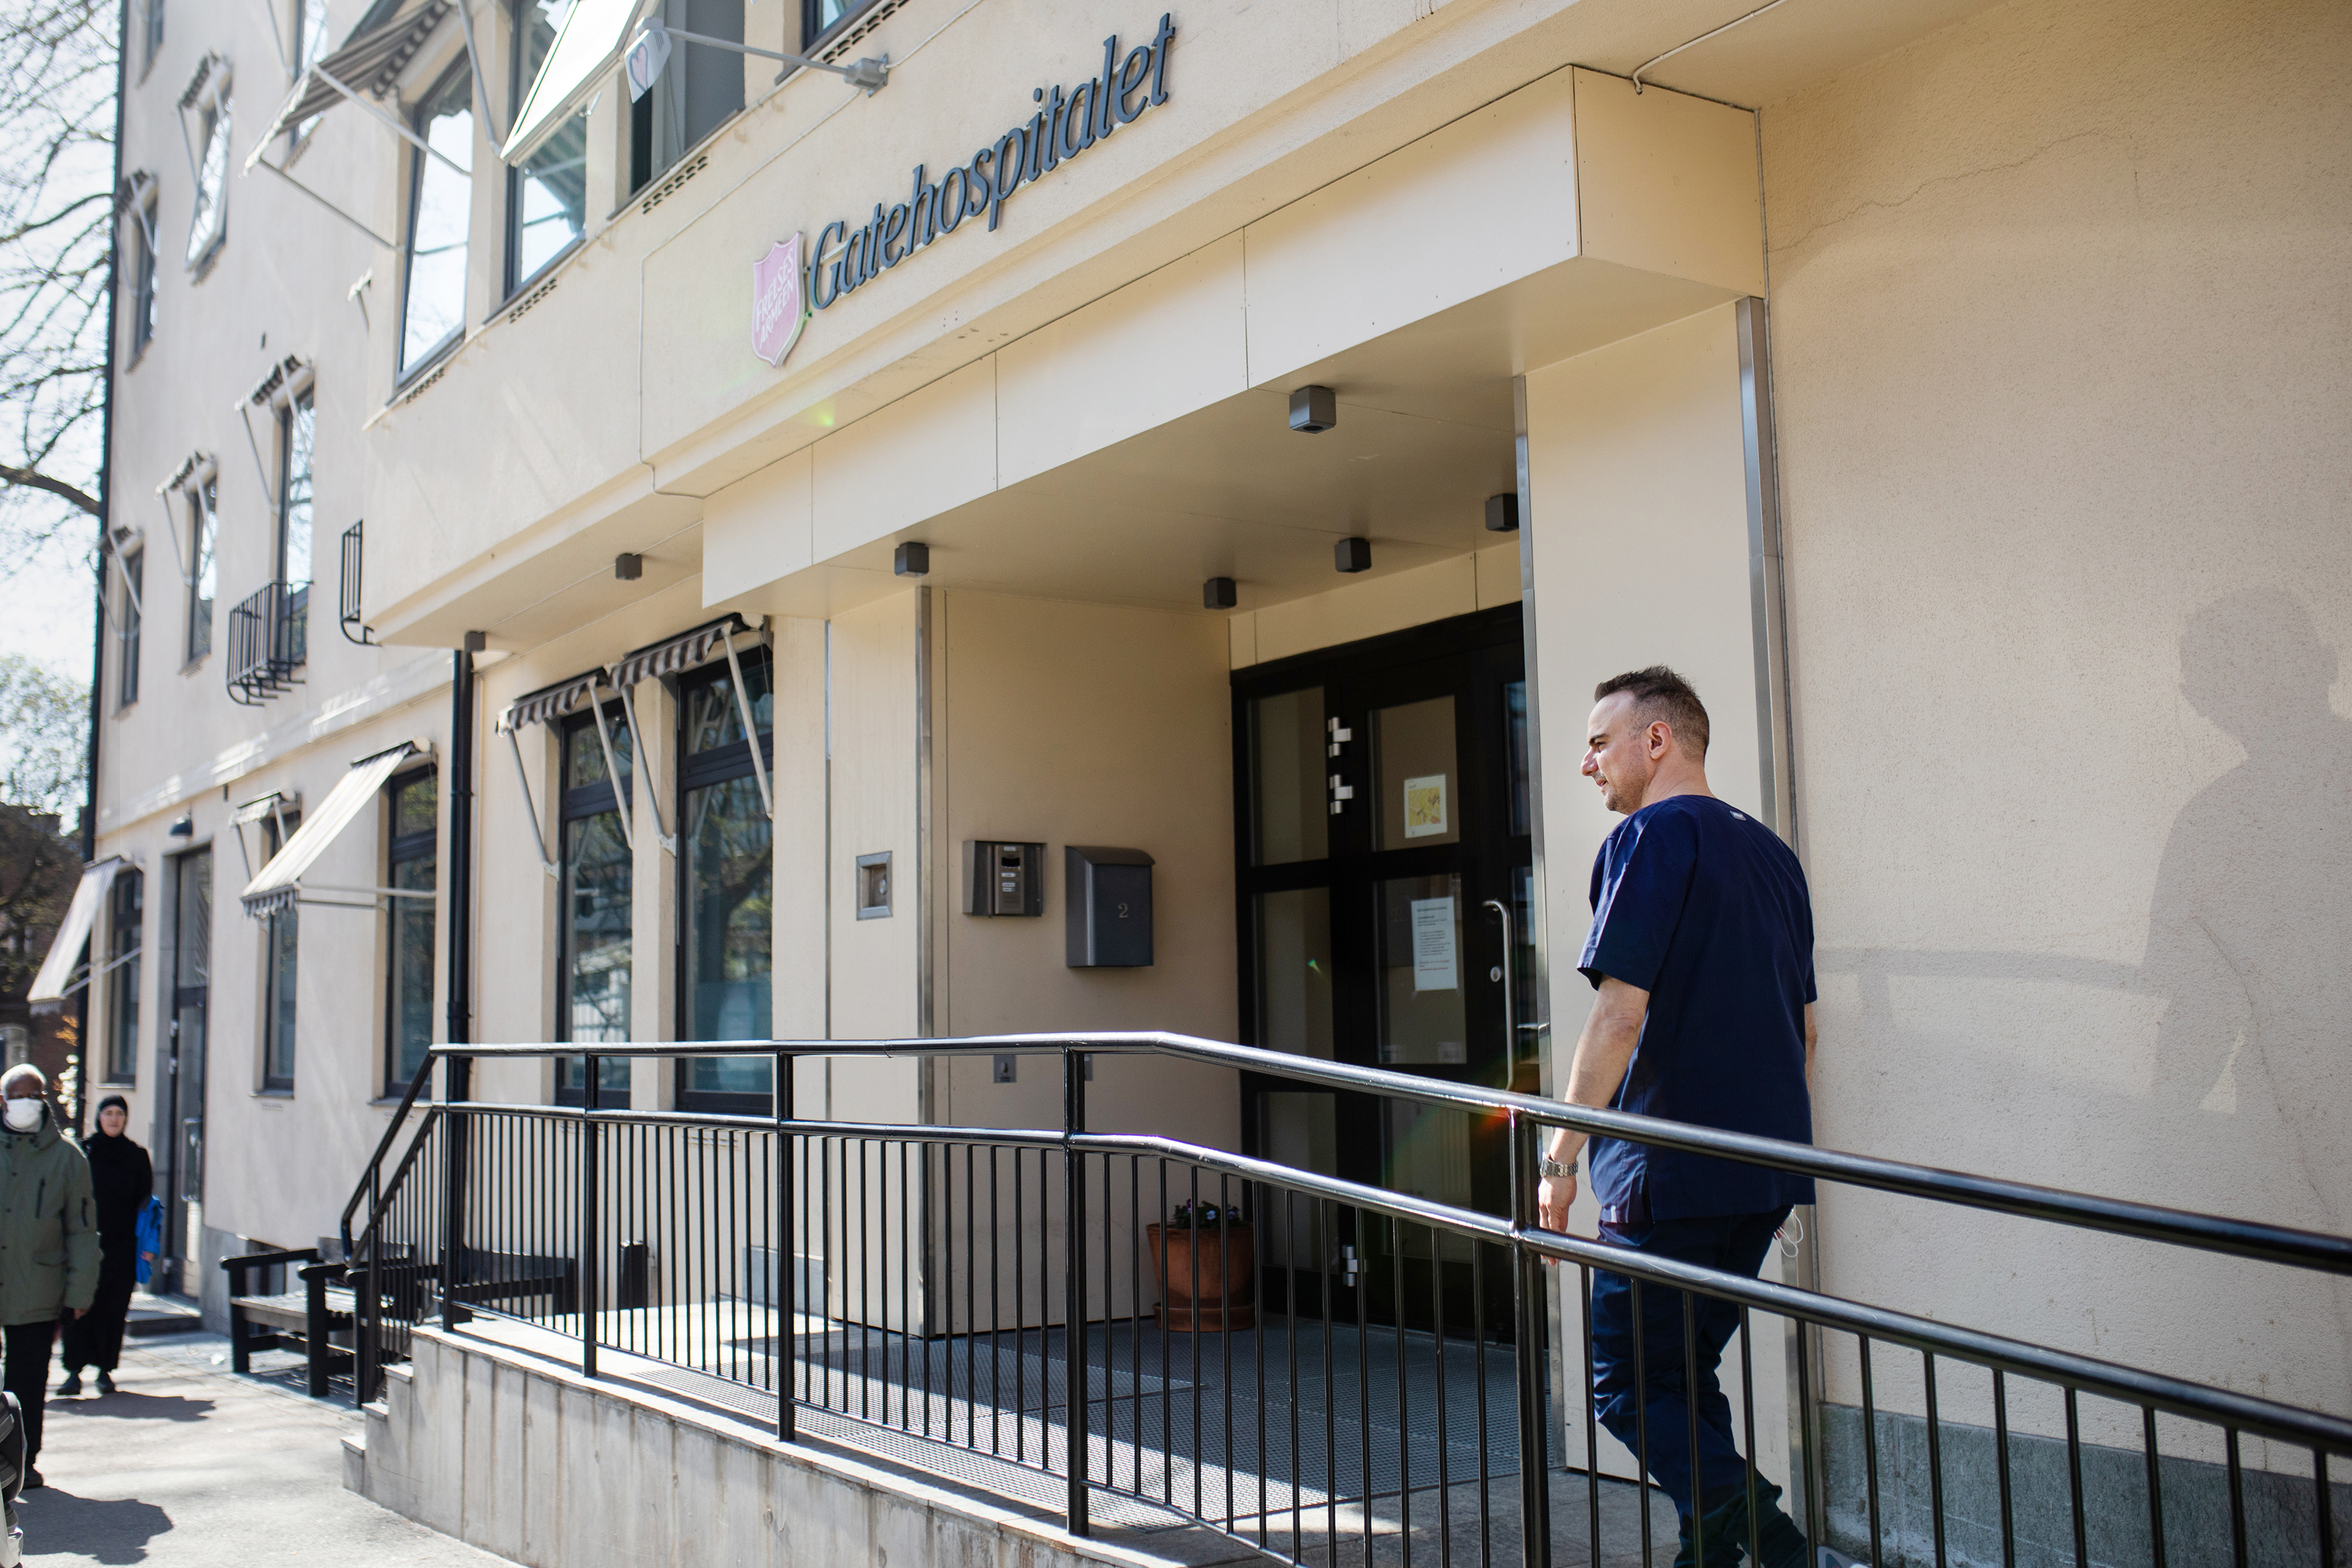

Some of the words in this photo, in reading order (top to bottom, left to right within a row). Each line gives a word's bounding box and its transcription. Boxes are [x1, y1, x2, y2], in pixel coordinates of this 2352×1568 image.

[809, 13, 1175, 310] Gatehospitalet
[756, 247, 794, 332] FRELSES
[759, 272, 794, 350] ARMEEN
[1118, 903, 1129, 918] 2
